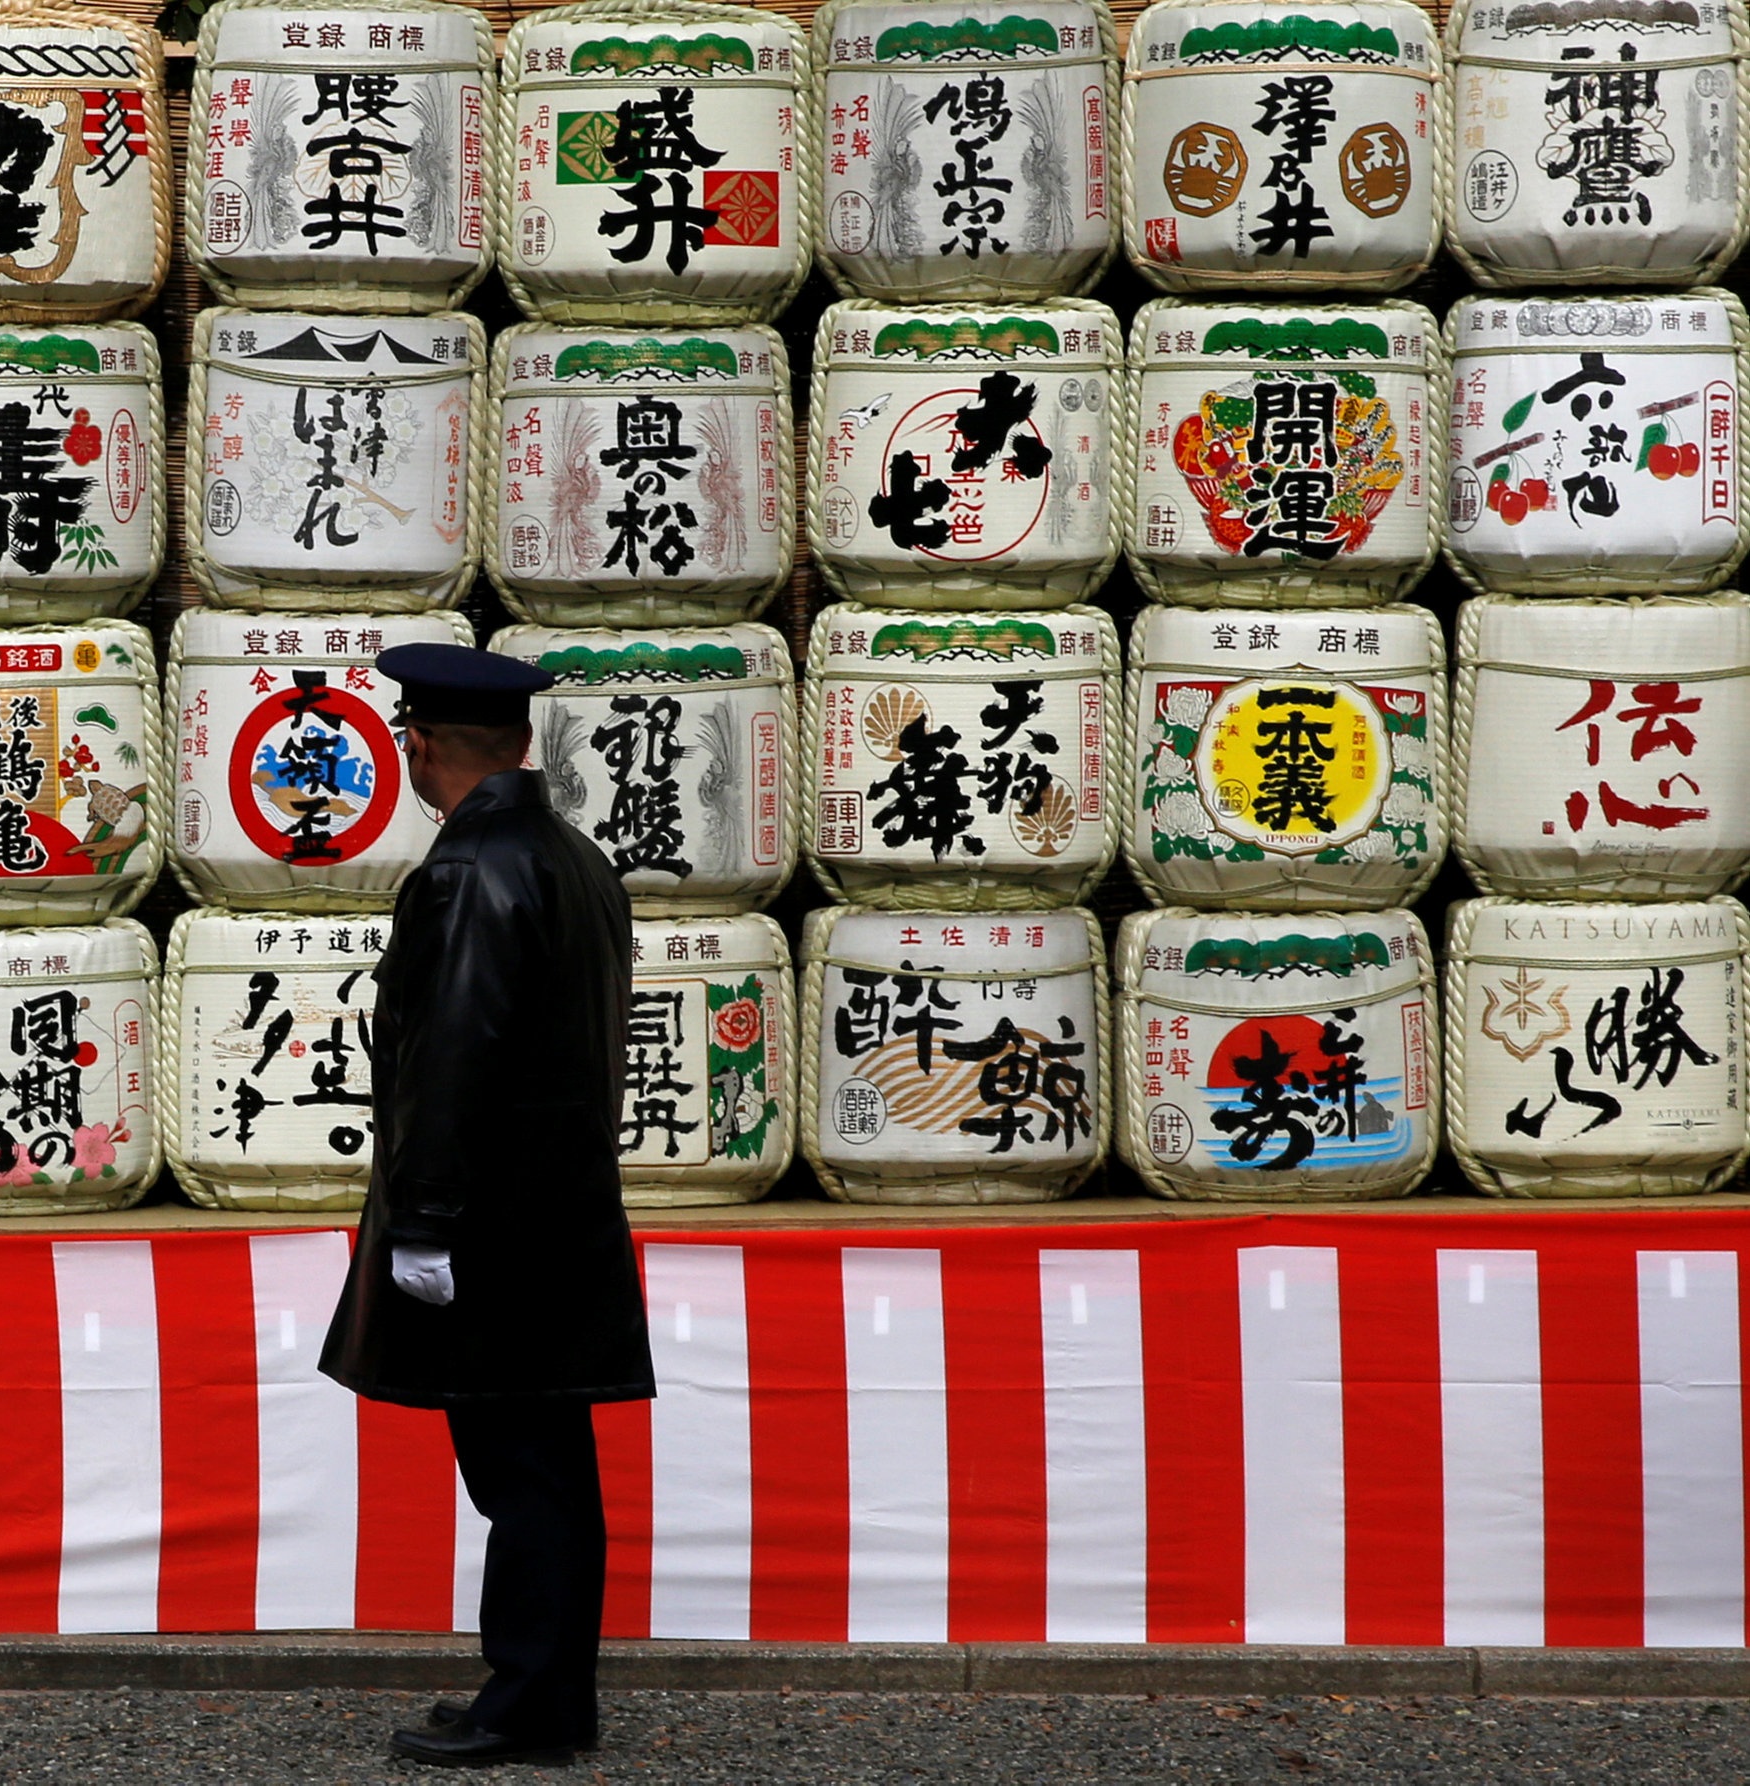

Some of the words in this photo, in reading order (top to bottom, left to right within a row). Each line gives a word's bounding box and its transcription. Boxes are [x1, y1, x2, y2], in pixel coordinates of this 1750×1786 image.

[282, 22, 346, 49] 登録
[369, 24, 425, 51] 商標
[850, 95, 871, 159] 名聲
[1545, 42, 1664, 226] 神鷹
[923, 71, 1013, 259] 鳩正宗
[1249, 76, 1336, 258] 澤乃井
[524, 408, 544, 477] 名聲
[839, 422, 855, 466] 天下
[1243, 382, 1349, 558] 開運
[600, 395, 698, 577] 奥の松
[243, 629, 302, 655] 登録
[325, 630, 385, 654] 商標
[1212, 623, 1280, 650] 登録
[1318, 627, 1380, 655] 商標
[250, 667, 277, 694] 金
[345, 666, 375, 690] 紋
[972, 680, 1060, 817] 天狗
[1251, 688, 1337, 833] 一本義
[1555, 680, 1710, 832] 伝心
[1265, 835, 1319, 844] IPPONGI
[256, 929, 312, 953] 伊予
[329, 927, 386, 953] 道後
[666, 934, 723, 960] 商標
[900, 926, 1044, 947] 土佐清酒
[1505, 918, 1727, 940] KATSUYAMA
[7, 990, 84, 1167] 同期の
[1167, 1015, 1193, 1081] 名聲
